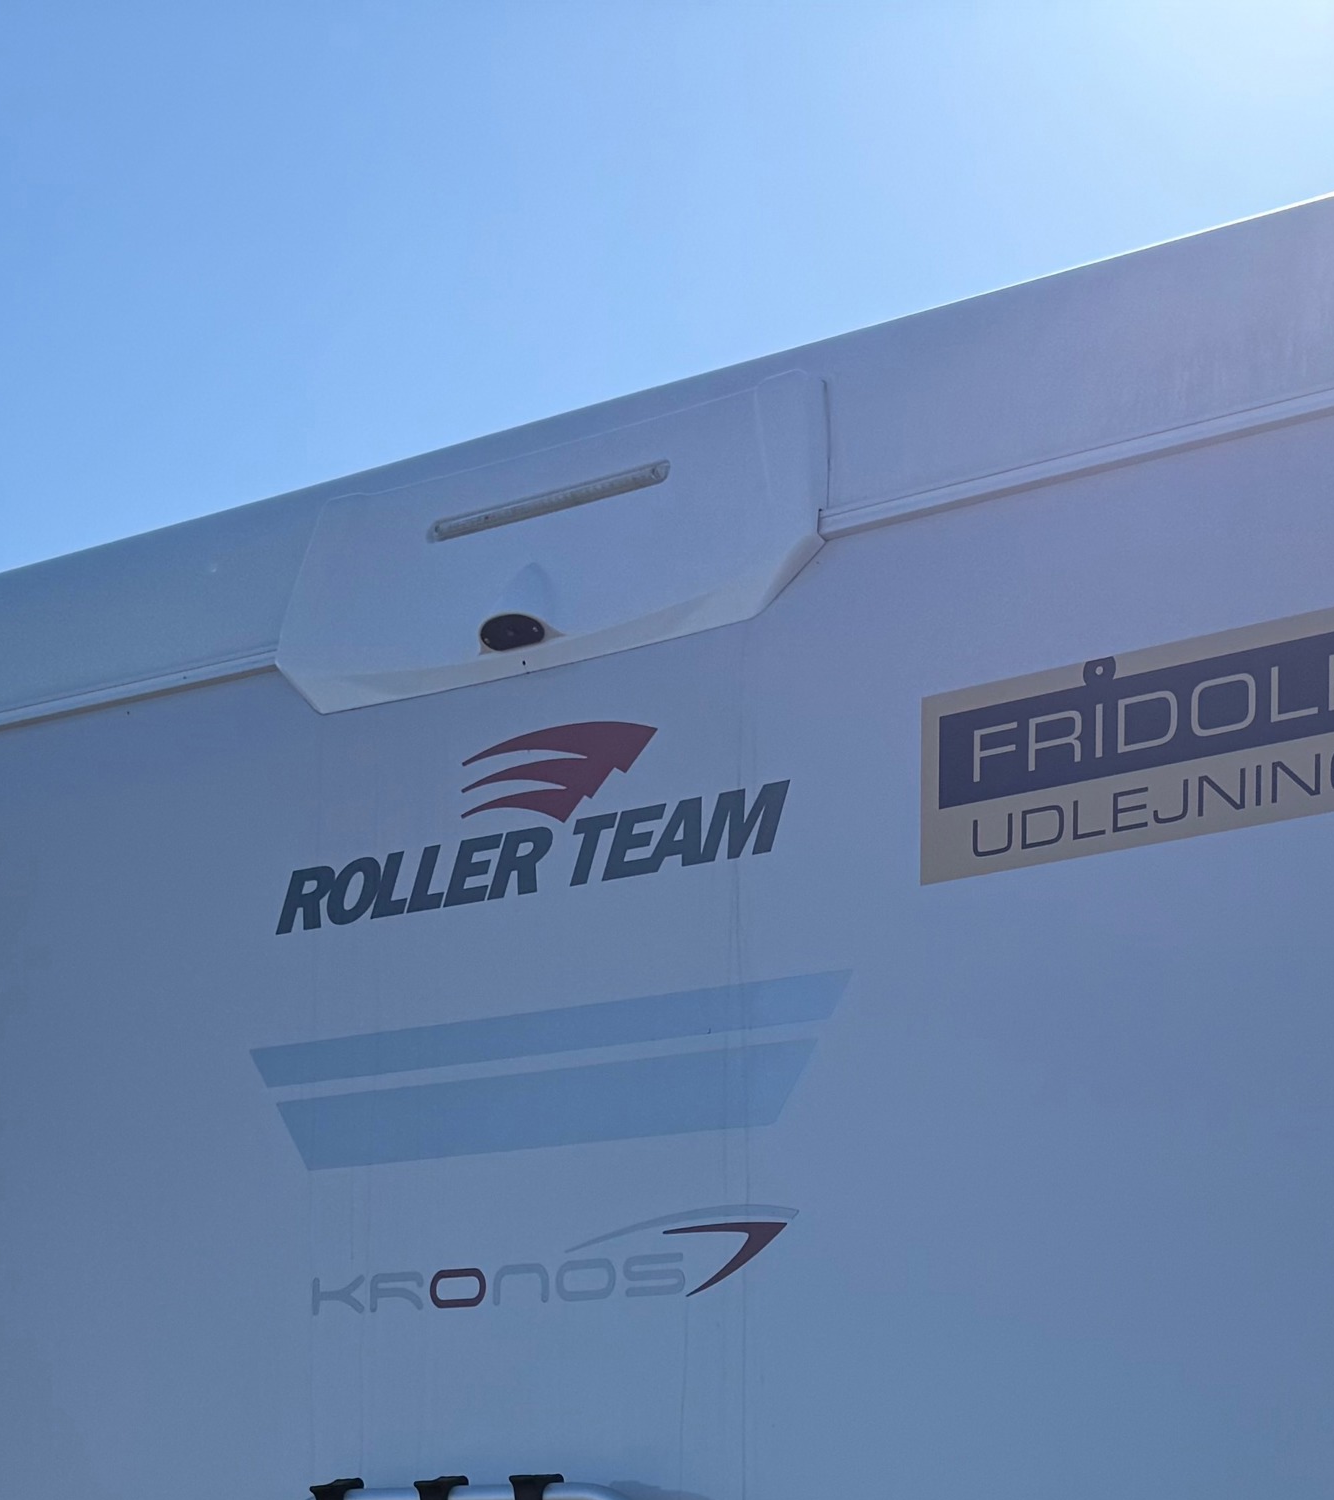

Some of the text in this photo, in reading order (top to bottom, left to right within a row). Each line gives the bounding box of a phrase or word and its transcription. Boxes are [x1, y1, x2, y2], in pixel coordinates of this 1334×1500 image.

[274, 779, 791, 936] ROLLER TEAM
[311, 1252, 687, 1317] KRONOS
